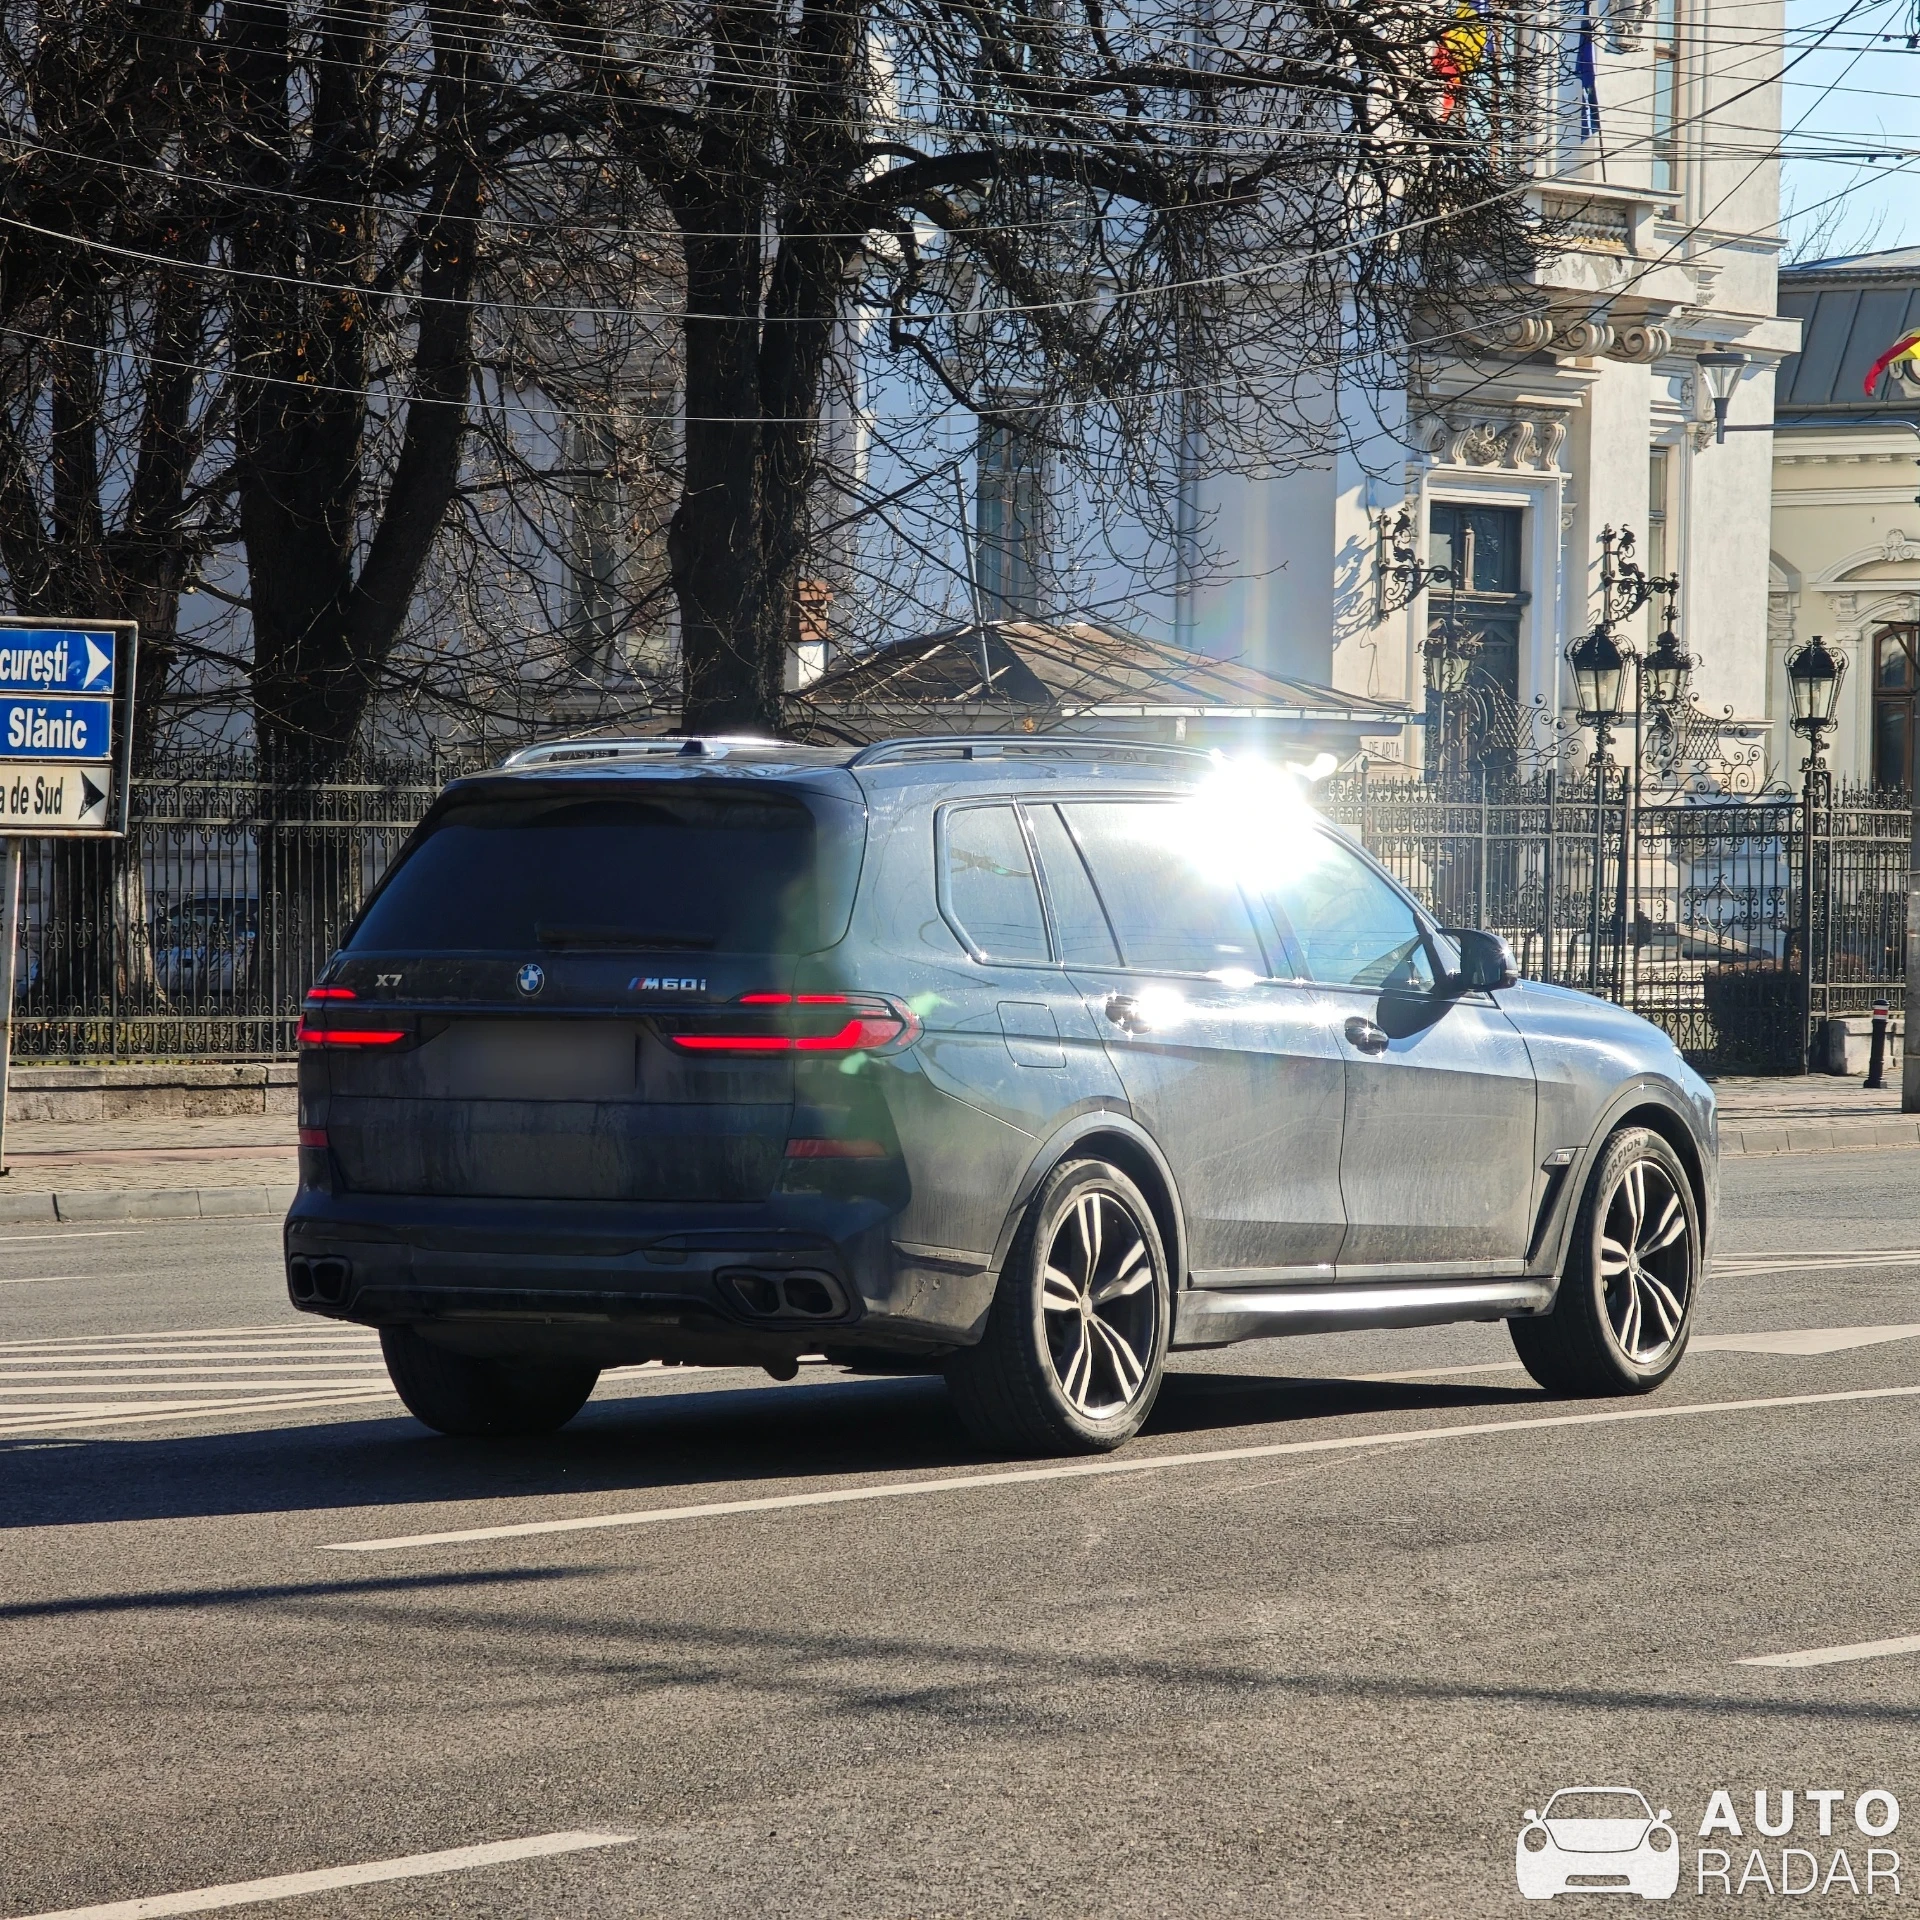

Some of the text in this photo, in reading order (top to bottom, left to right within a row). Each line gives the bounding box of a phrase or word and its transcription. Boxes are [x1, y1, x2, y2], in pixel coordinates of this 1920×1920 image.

[0, 640, 69, 690] curești
[7, 706, 88, 750] Slănic
[1369, 741, 1379, 758] DE
[10, 775, 29, 815] de
[34, 775, 64, 815] Sud
[374, 974, 403, 987] X7
[641, 977, 706, 991] M60i
